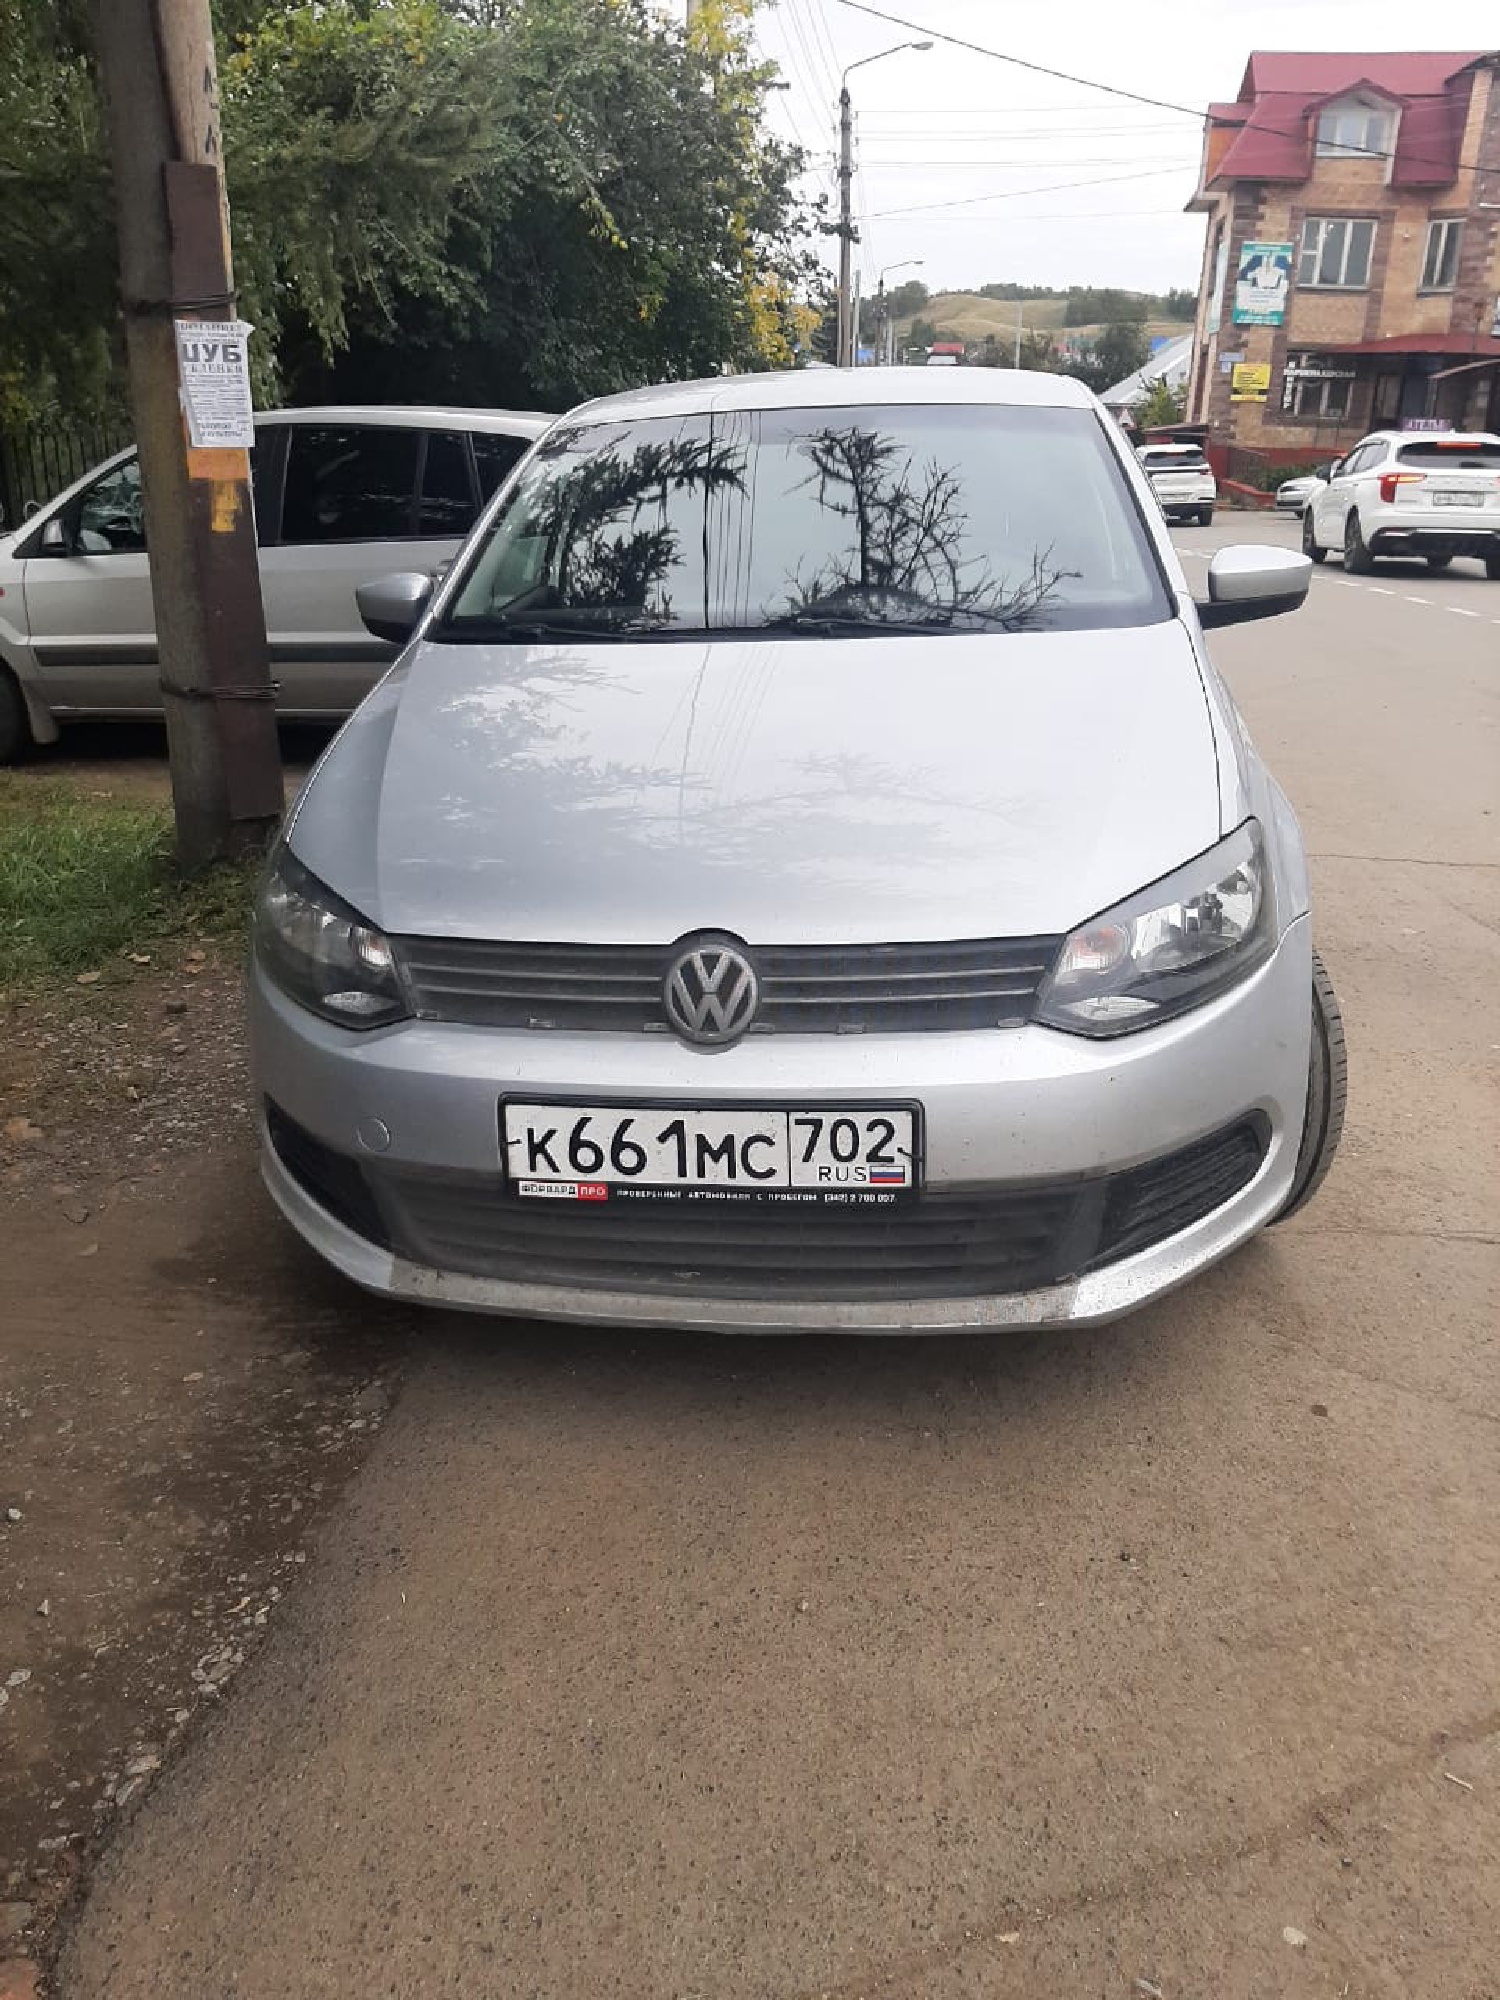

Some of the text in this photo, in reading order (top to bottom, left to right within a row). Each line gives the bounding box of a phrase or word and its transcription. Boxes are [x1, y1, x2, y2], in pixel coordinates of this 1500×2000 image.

[794, 1118, 896, 1163] 702
[818, 1165, 868, 1182] RUS
[580, 1186, 606, 1196] ПРО
